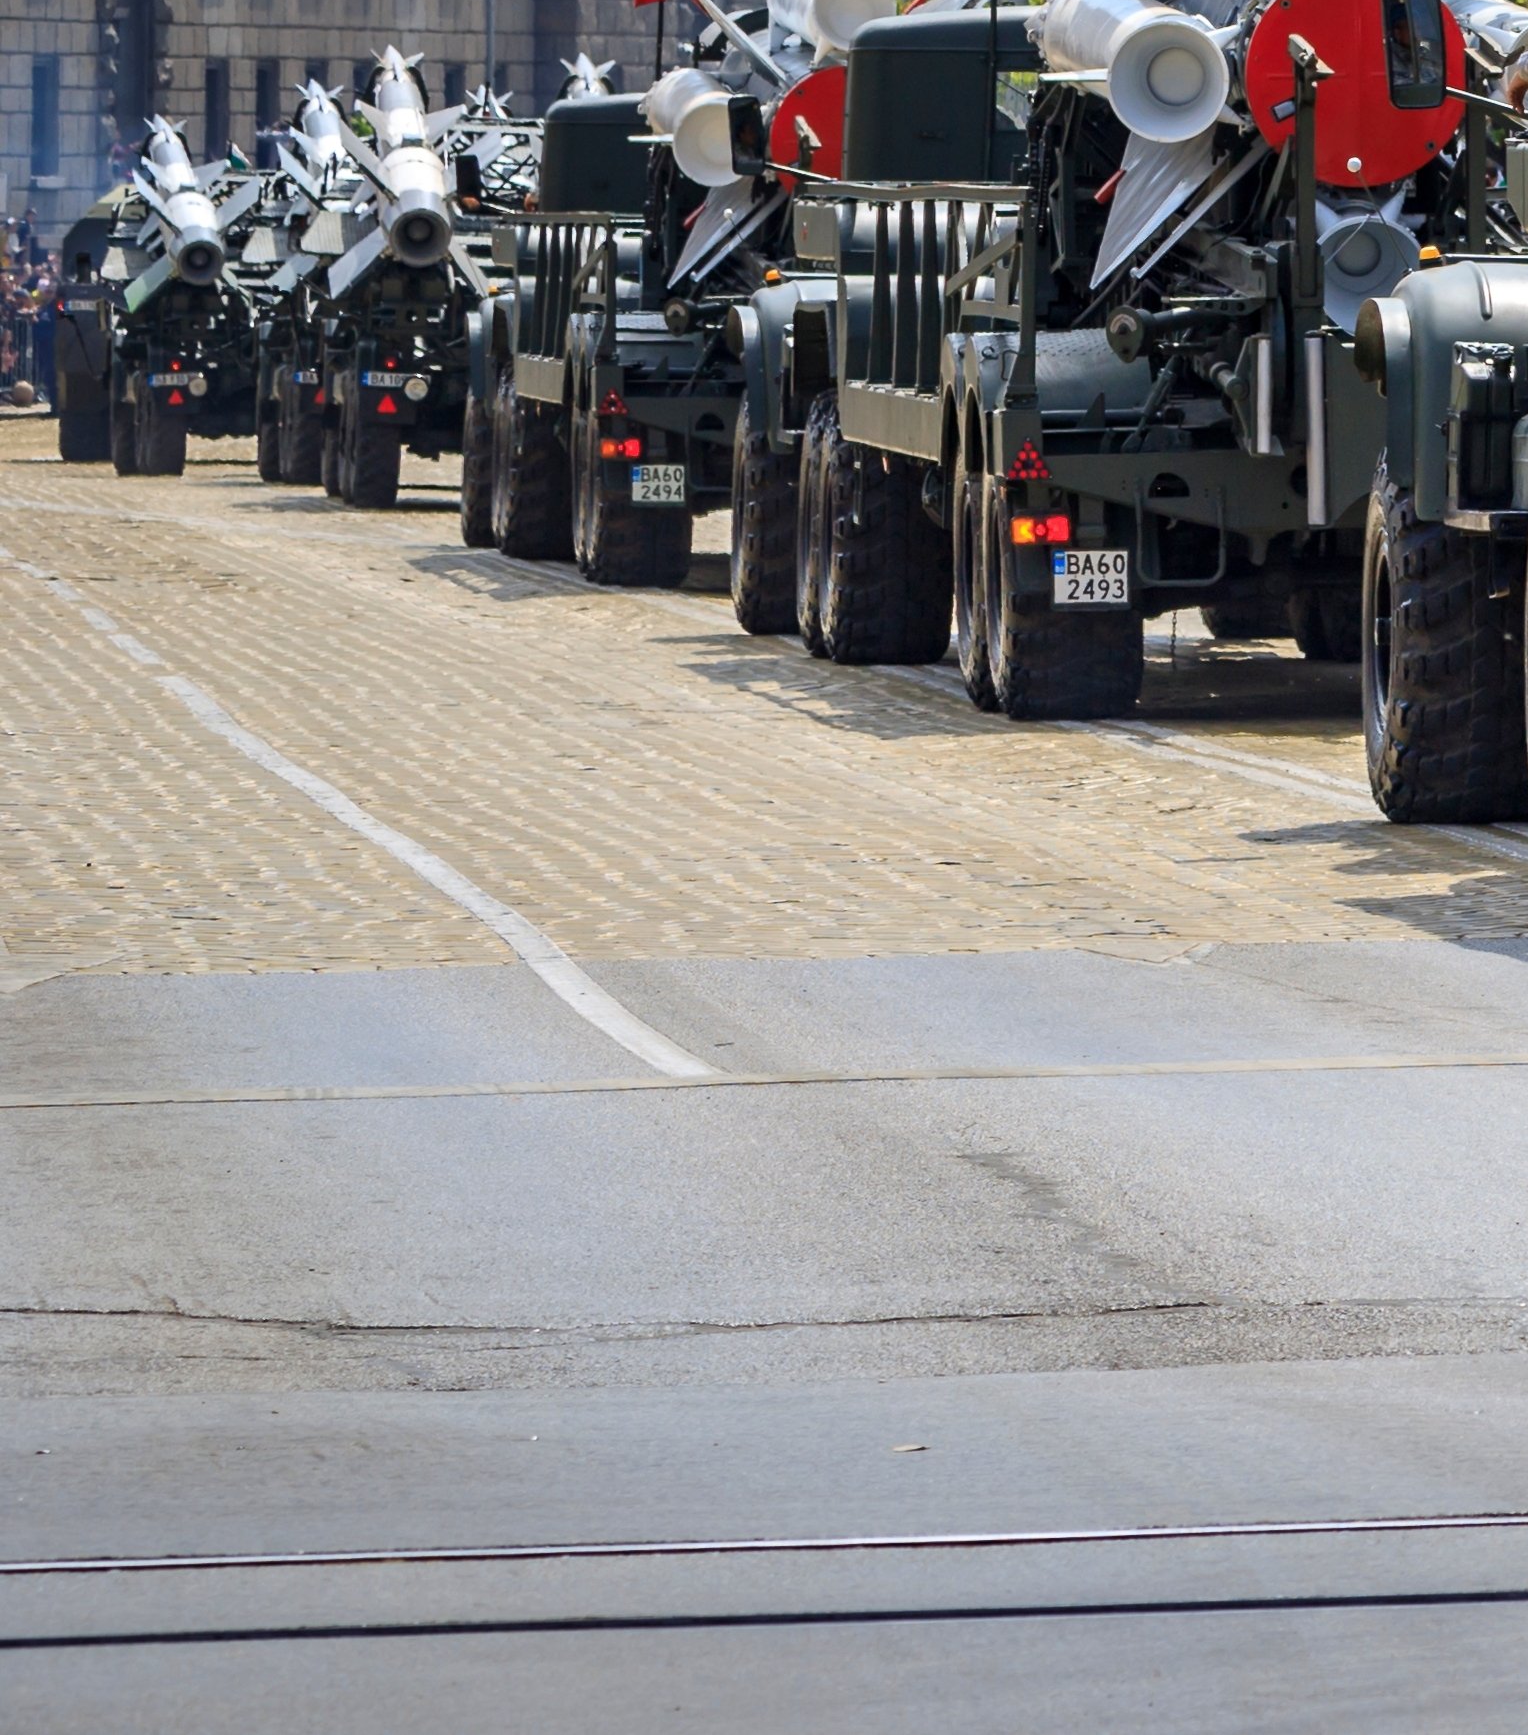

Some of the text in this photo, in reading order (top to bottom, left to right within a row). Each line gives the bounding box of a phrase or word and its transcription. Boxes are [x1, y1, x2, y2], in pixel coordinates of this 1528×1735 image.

[641, 467, 683, 483] BA60
[641, 484, 682, 500] 2494
[1067, 554, 1126, 576] BA60
[1067, 578, 1125, 600] 2493
